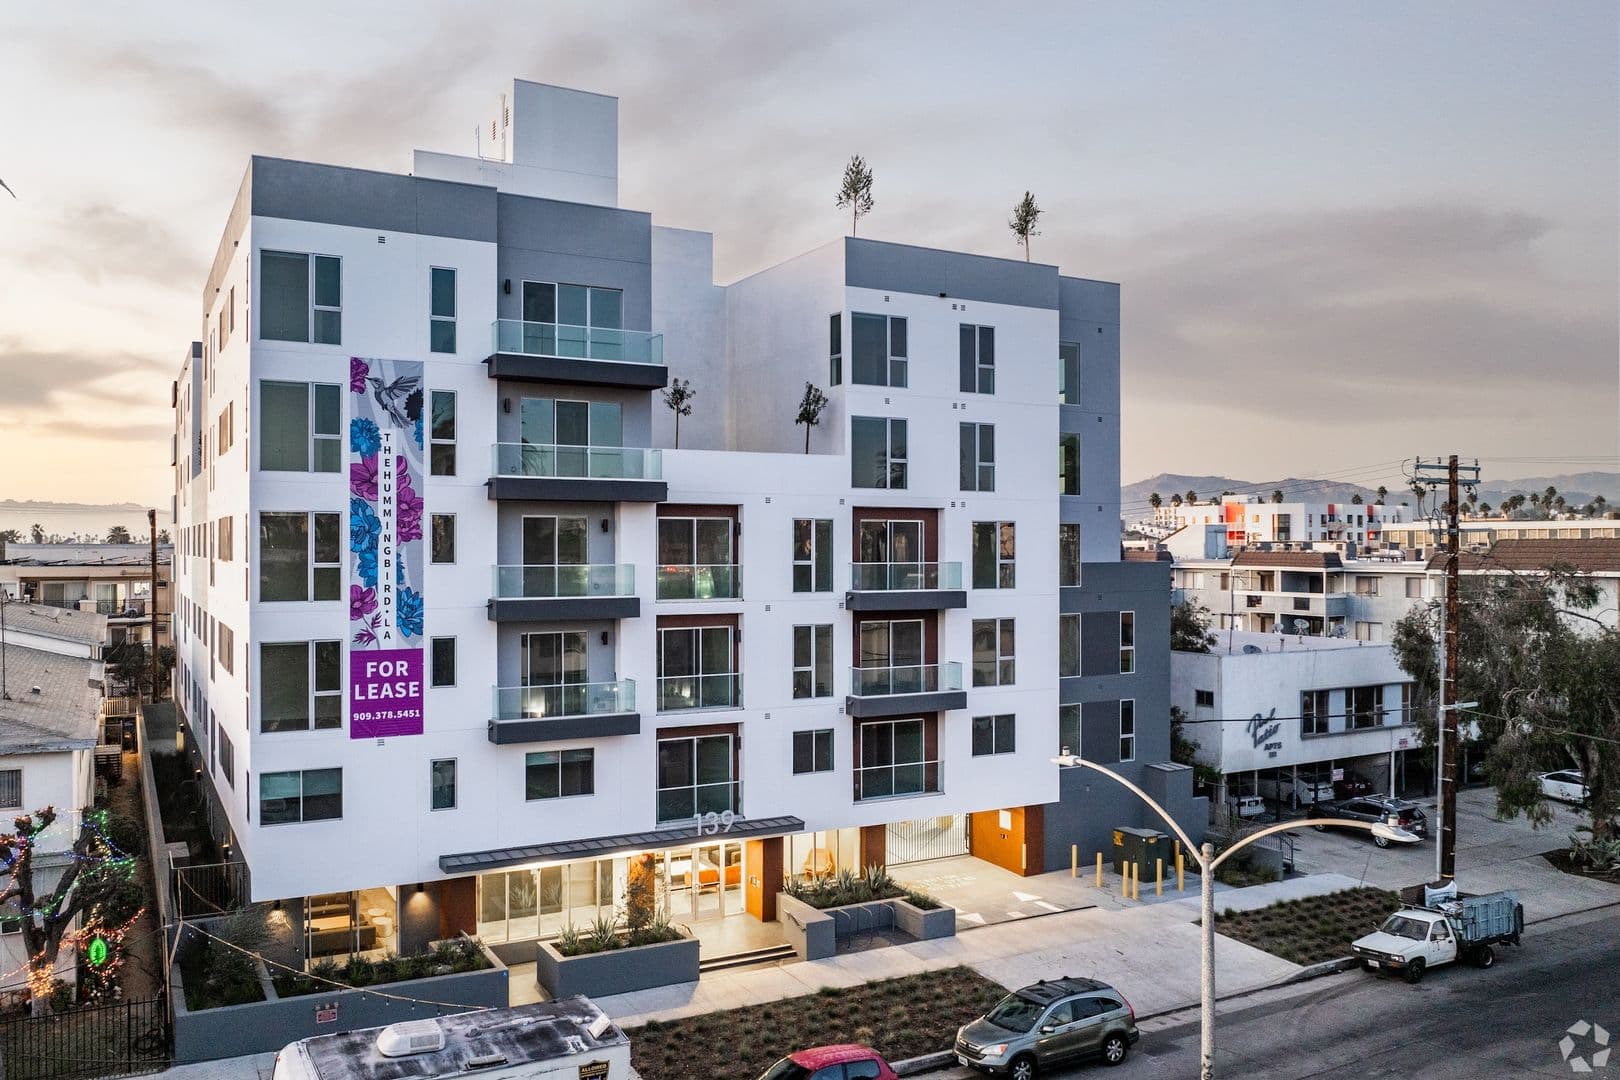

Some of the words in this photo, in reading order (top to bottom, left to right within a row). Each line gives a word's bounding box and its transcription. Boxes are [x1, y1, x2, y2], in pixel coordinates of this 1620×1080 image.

[366, 660, 409, 678] FOR
[354, 681, 420, 701] LEASE
[353, 709, 421, 721] 909.378.5451
[693, 809, 735, 836] 139
